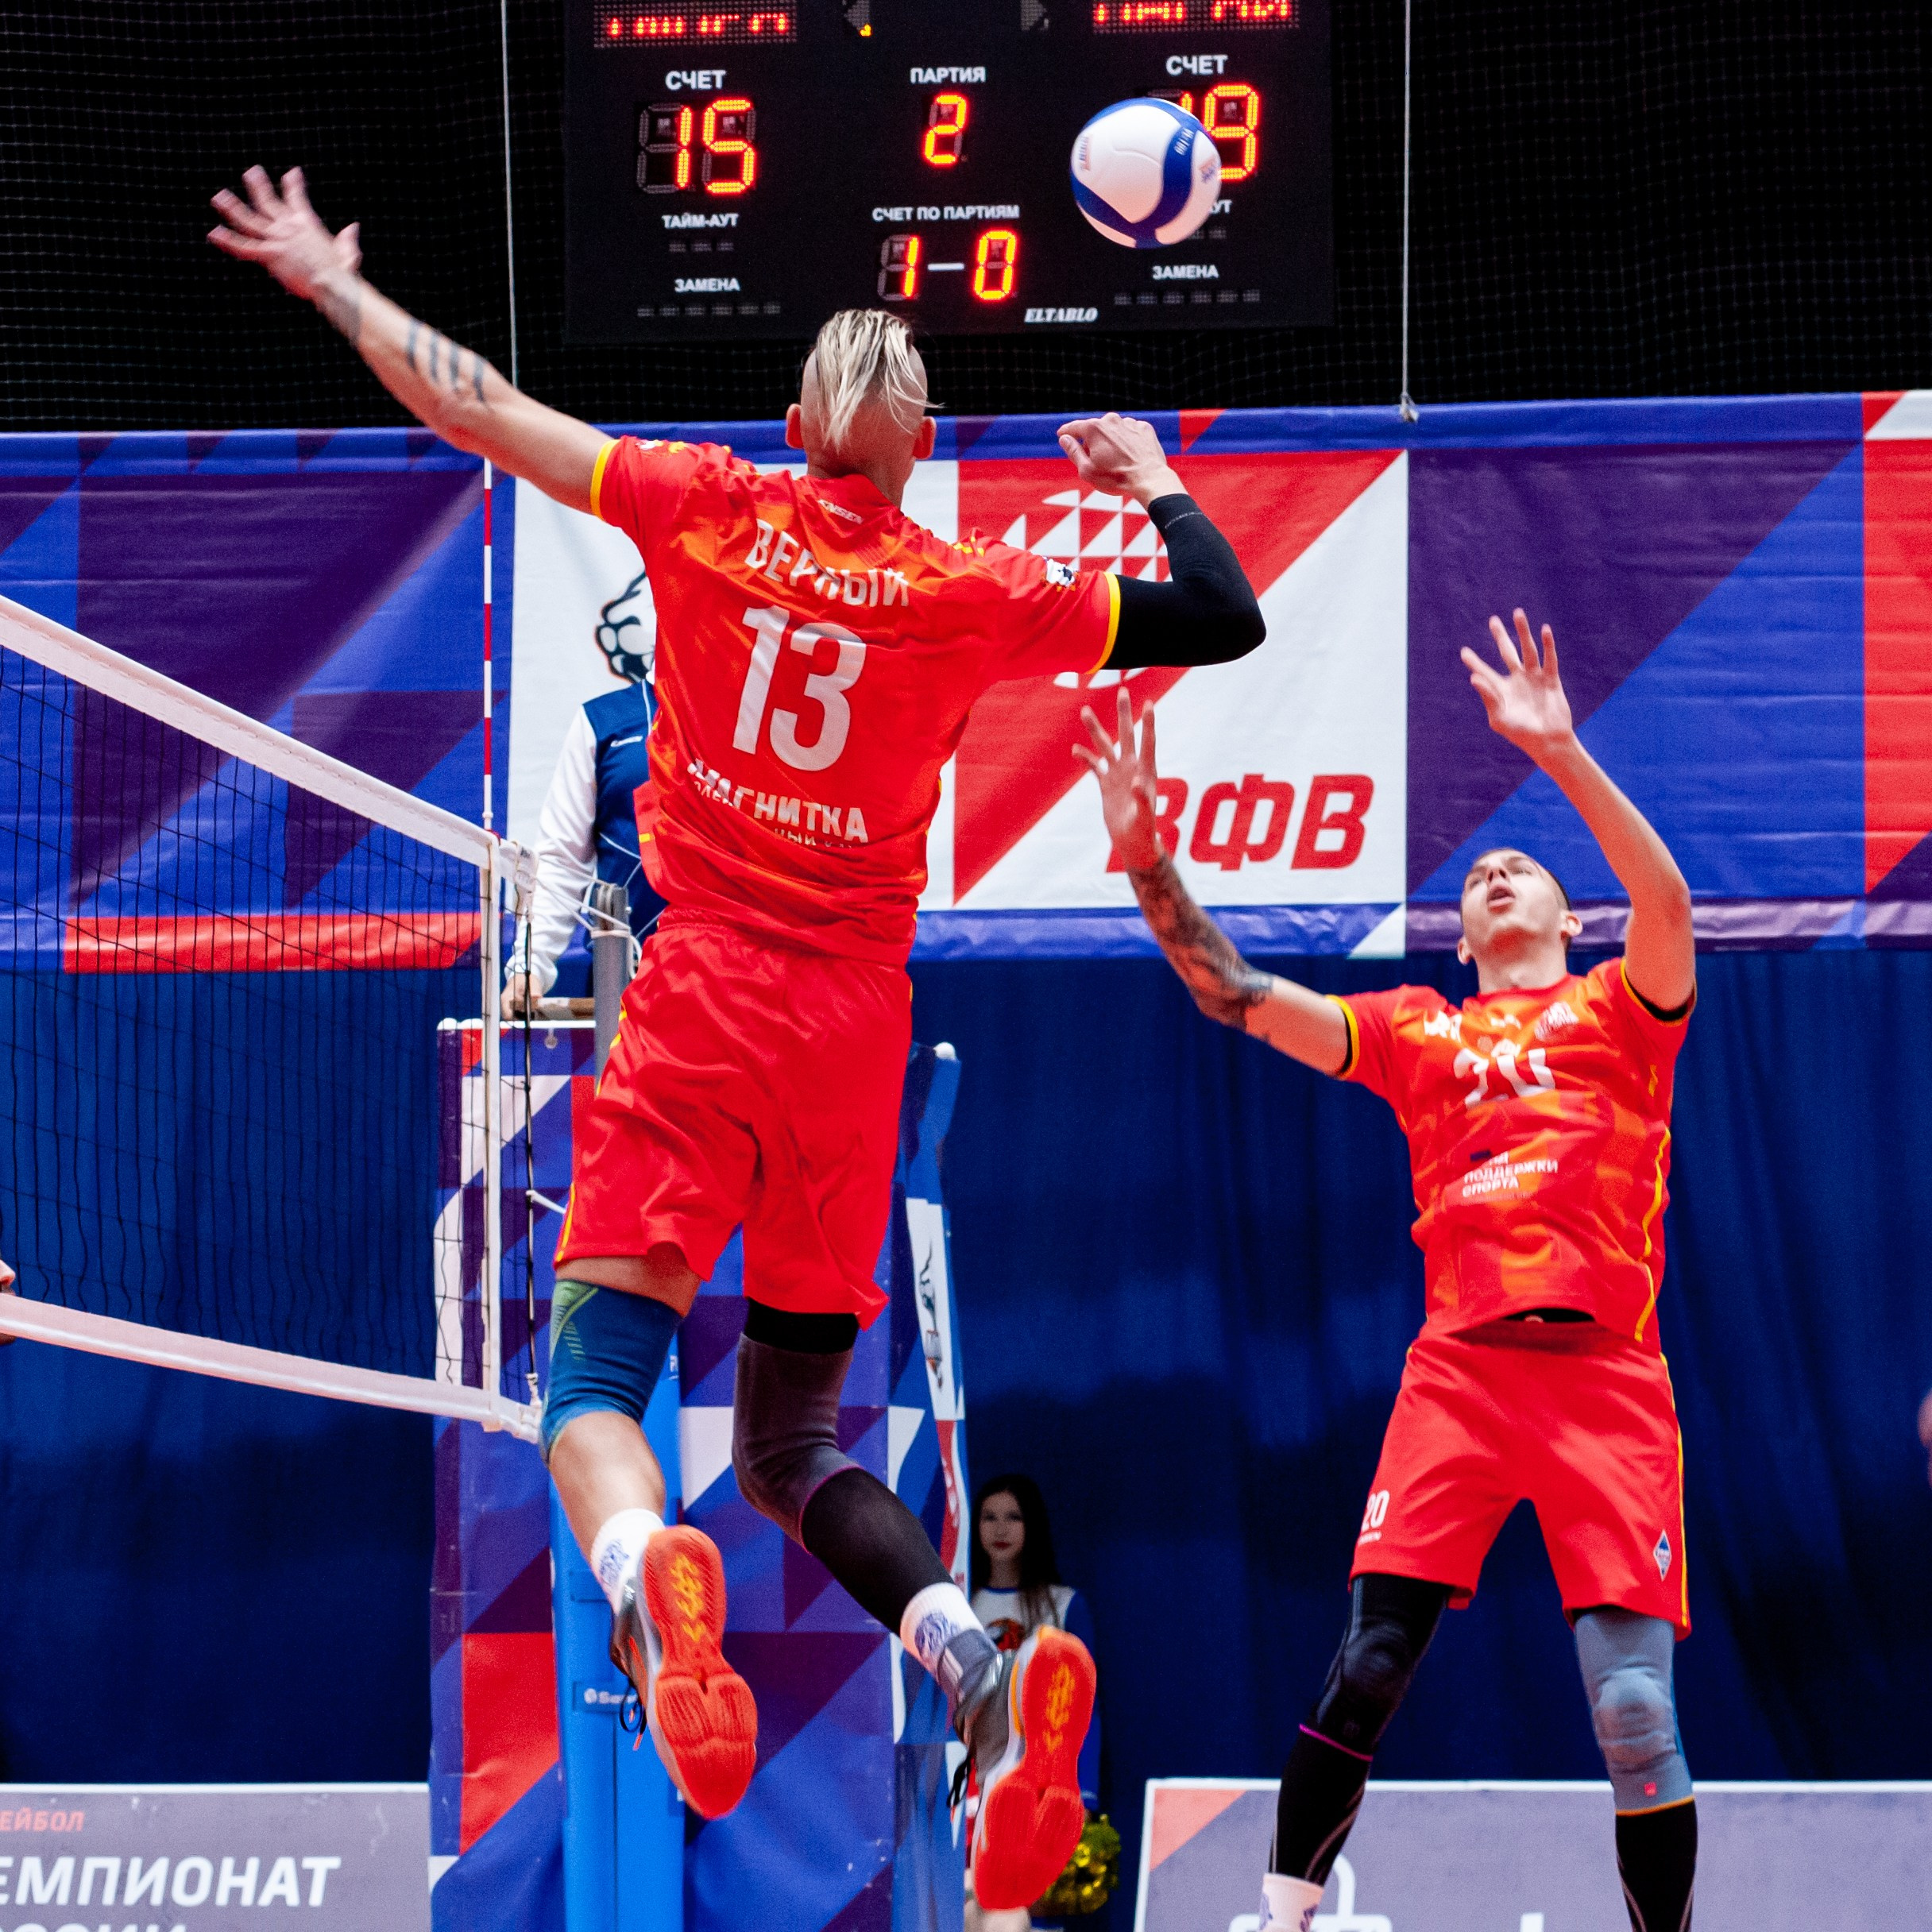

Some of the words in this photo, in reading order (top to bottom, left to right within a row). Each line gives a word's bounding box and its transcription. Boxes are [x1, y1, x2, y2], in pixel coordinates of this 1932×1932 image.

[910, 66, 987, 84] ПАРТИЯ
[1165, 54, 1228, 76] СЧЕТ
[665, 69, 727, 91] СЧЕТ
[923, 94, 968, 165] 2
[1180, 83, 1260, 181] 9
[674, 98, 756, 195] 15
[661, 212, 739, 230] ТАЙМ-АУТ
[871, 207, 913, 222] СЧЕТ
[916, 207, 941, 221] ПО
[943, 204, 1020, 221] ПАРТИЯМ
[1153, 265, 1219, 280] ЗАМЕНА
[674, 277, 740, 293] ЗАМЕНА
[1024, 307, 1099, 323] ELTABLO
[732, 605, 867, 772] 13
